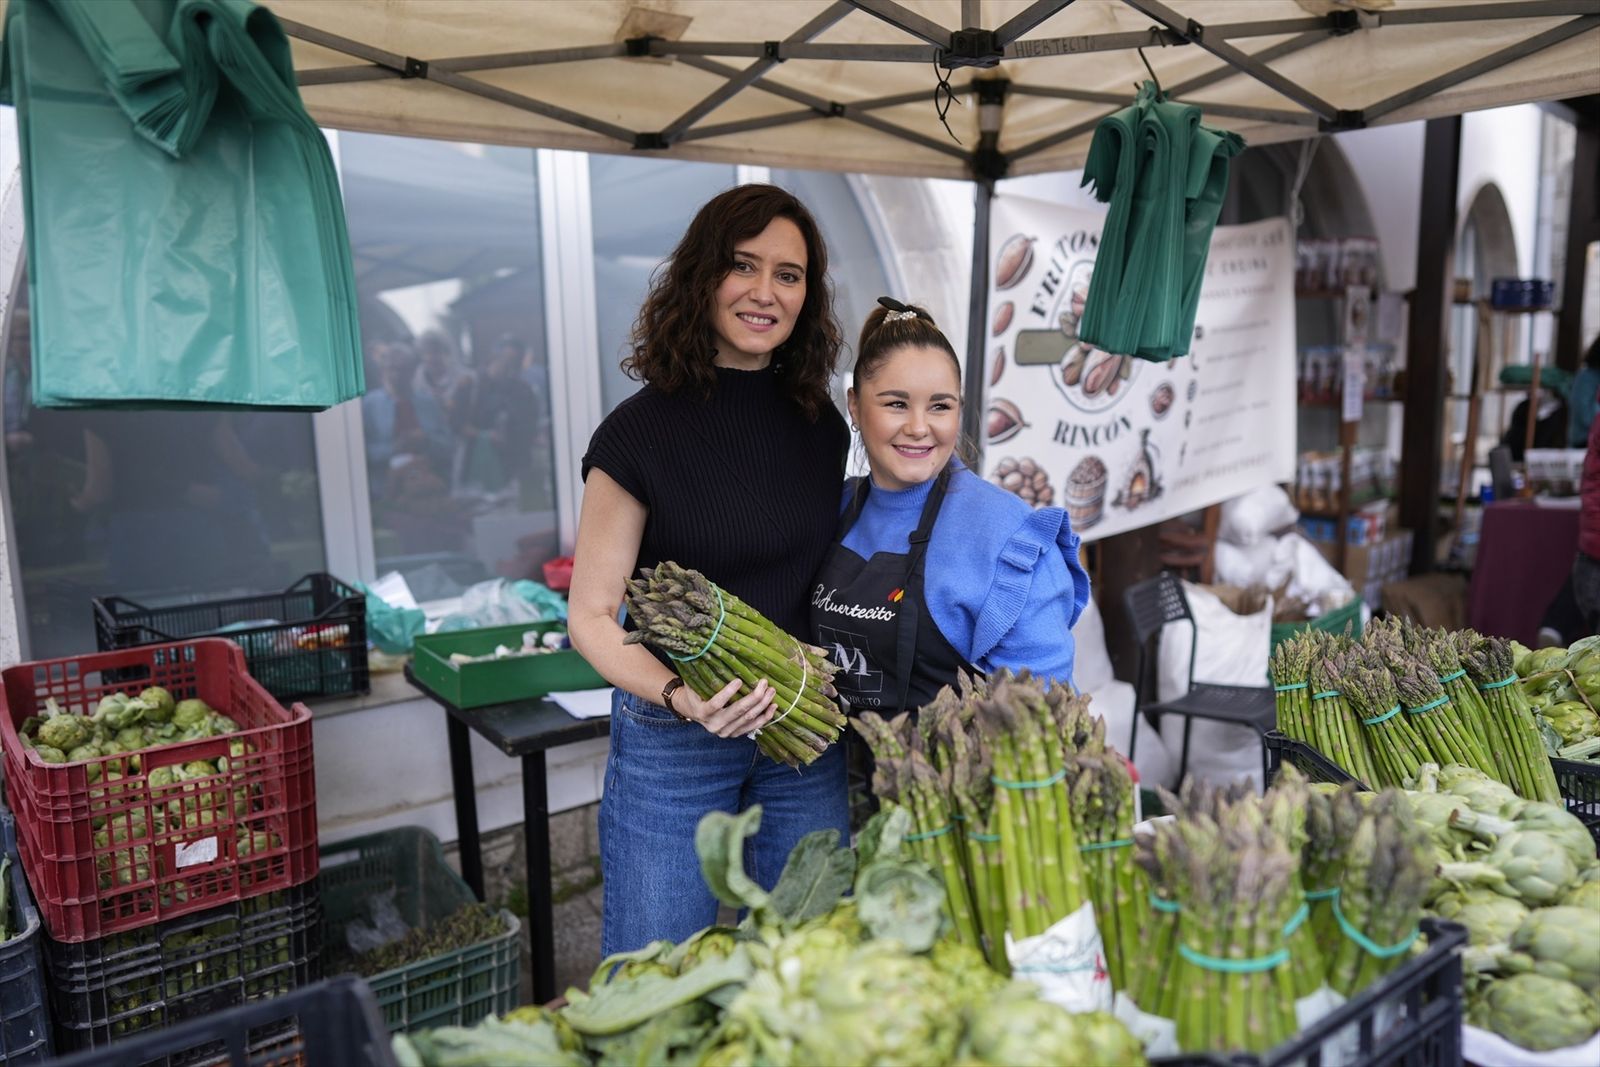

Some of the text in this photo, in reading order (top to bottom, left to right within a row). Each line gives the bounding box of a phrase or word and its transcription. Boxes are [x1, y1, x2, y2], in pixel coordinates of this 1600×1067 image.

[1029, 229, 1099, 318] FRITOS
[1052, 413, 1132, 447] RINCÓN
[818, 588, 896, 621] Huertecito
